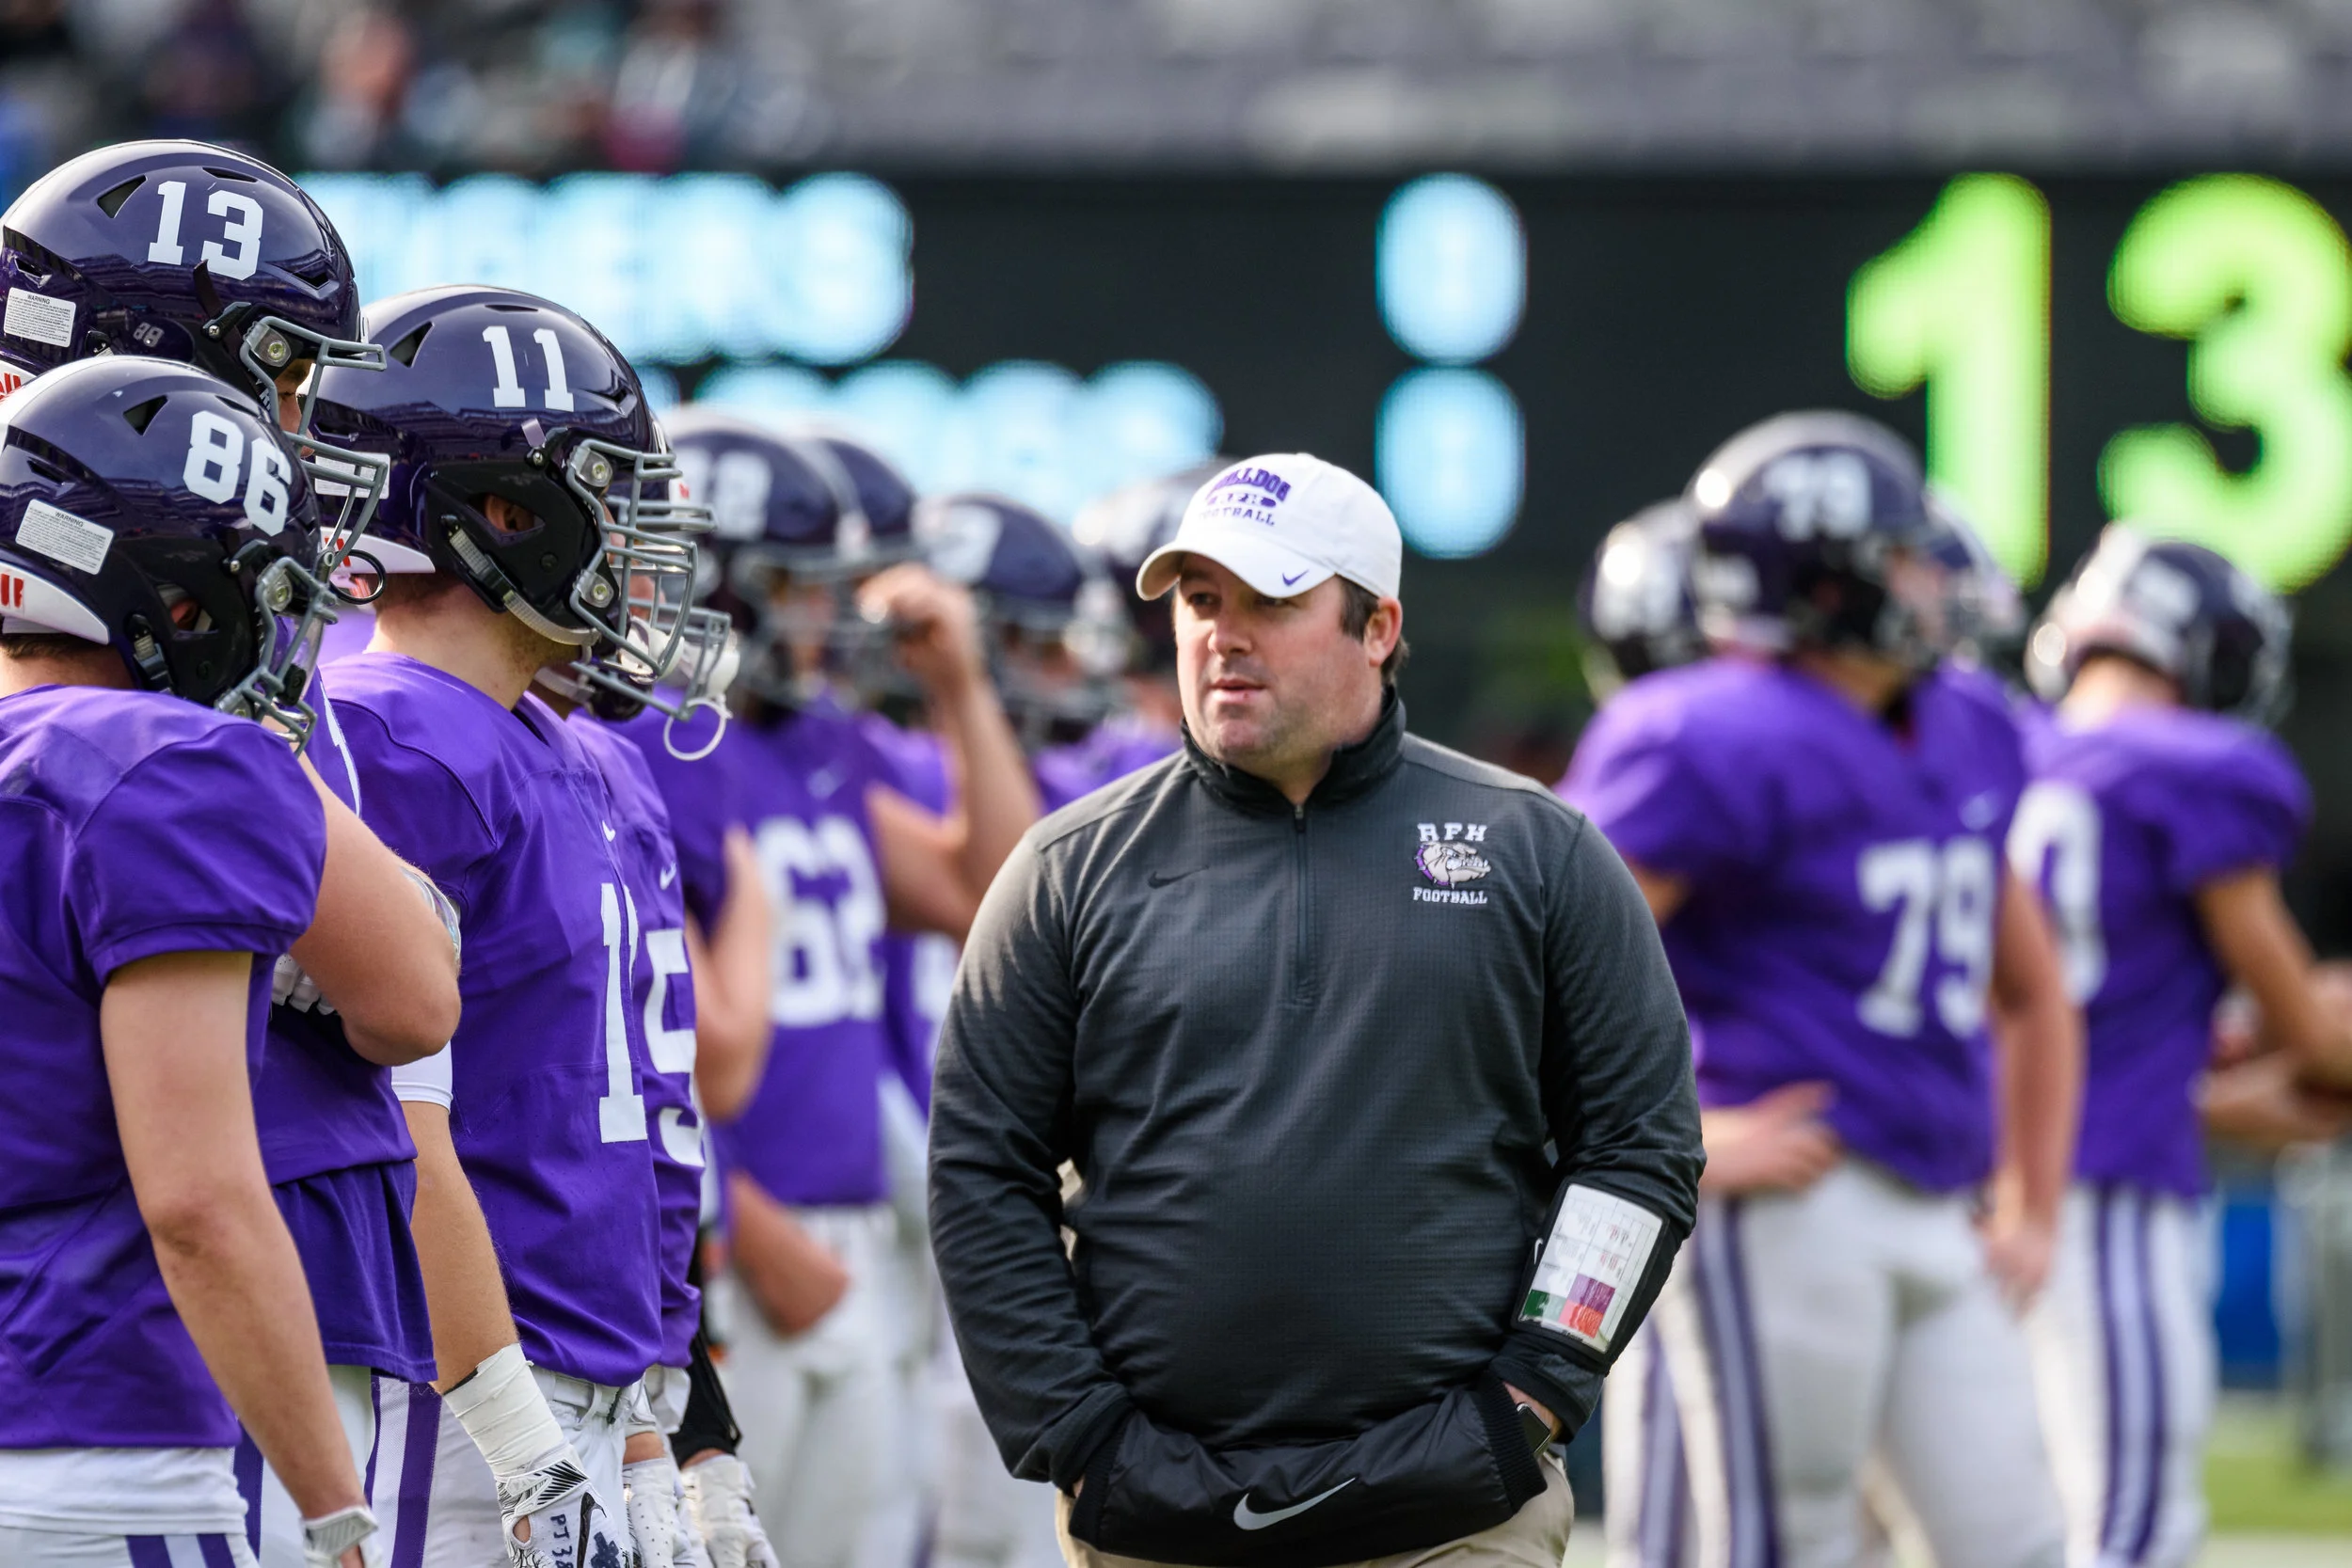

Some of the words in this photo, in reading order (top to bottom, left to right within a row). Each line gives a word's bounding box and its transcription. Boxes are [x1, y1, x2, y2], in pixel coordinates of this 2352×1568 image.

[147, 180, 264, 281] 13
[27, 294, 51, 305] WARNING
[482, 325, 575, 413] 11
[1847, 172, 2352, 595] 13
[183, 410, 293, 537] 86
[56, 511, 84, 528] WARNING
[1417, 822, 1487, 842] RFH
[1413, 886, 1488, 905] FOOTBALL
[1856, 835, 1998, 1040] 79
